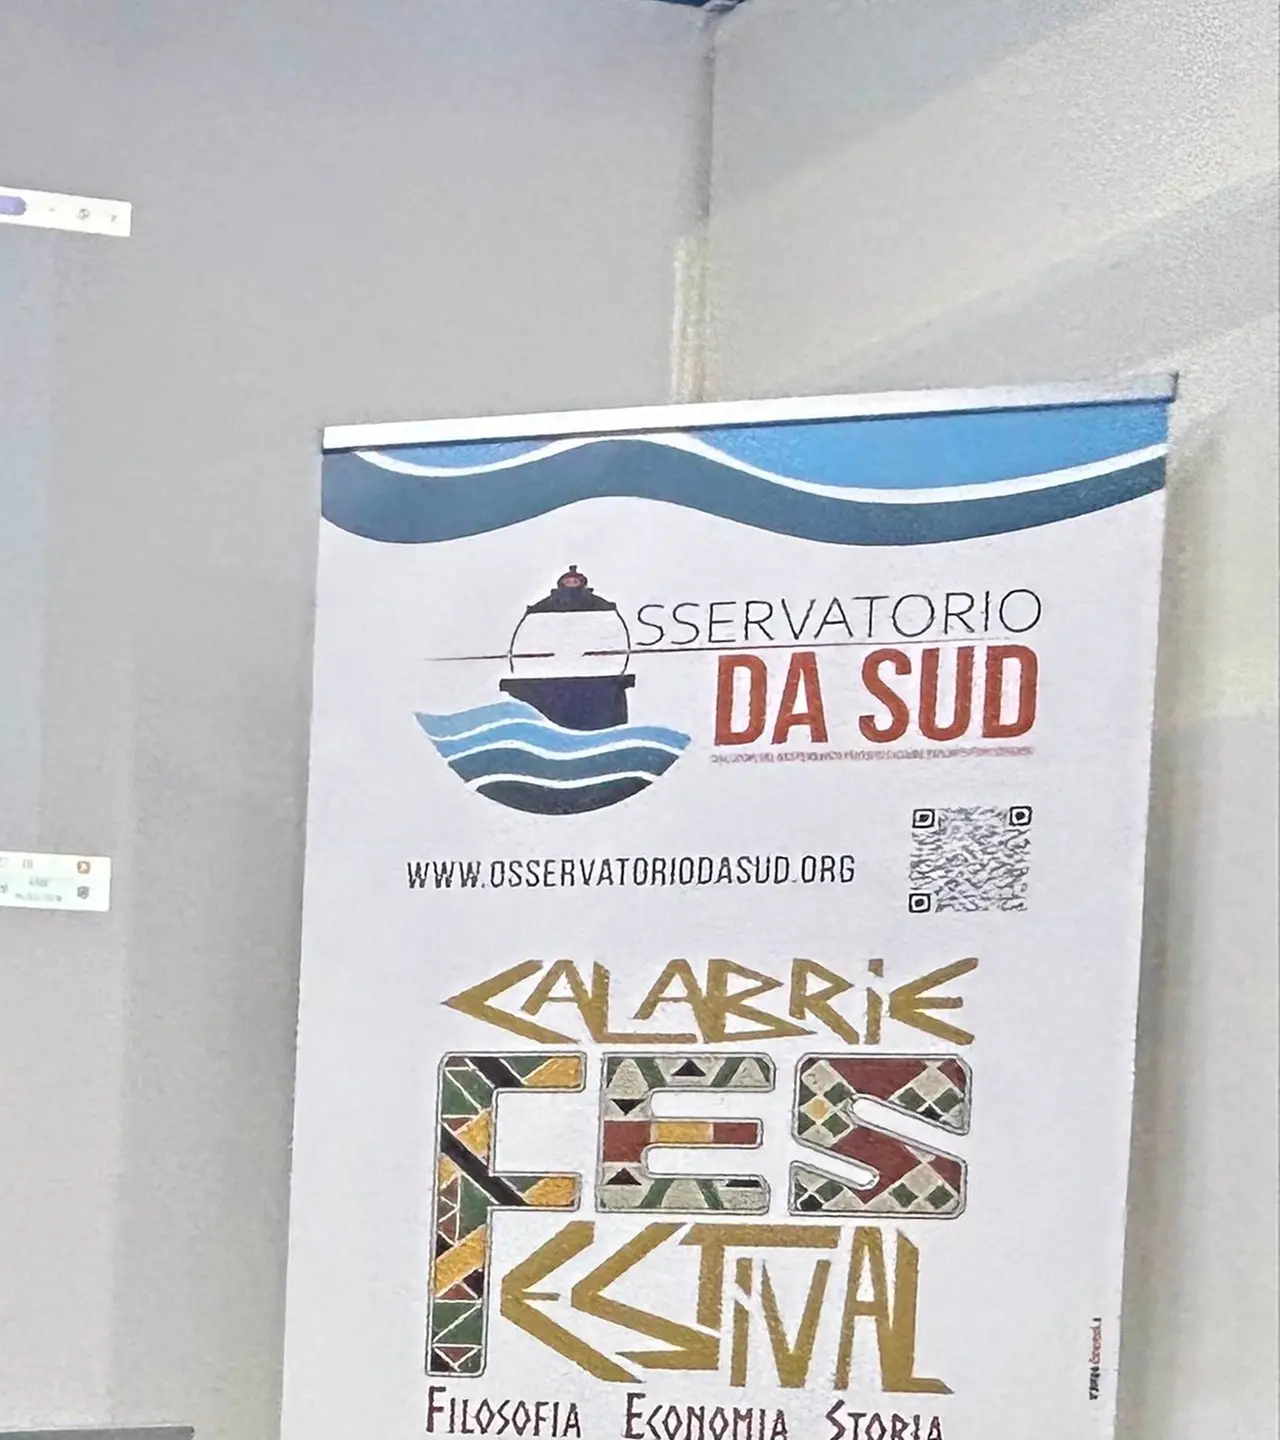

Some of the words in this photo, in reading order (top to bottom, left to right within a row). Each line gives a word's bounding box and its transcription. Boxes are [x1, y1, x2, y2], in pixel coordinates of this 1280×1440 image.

[714, 650, 828, 746] DA
[858, 642, 1038, 744] SUD
[406, 854, 856, 889] WWW.OSSERVATORIODASUD.ORG
